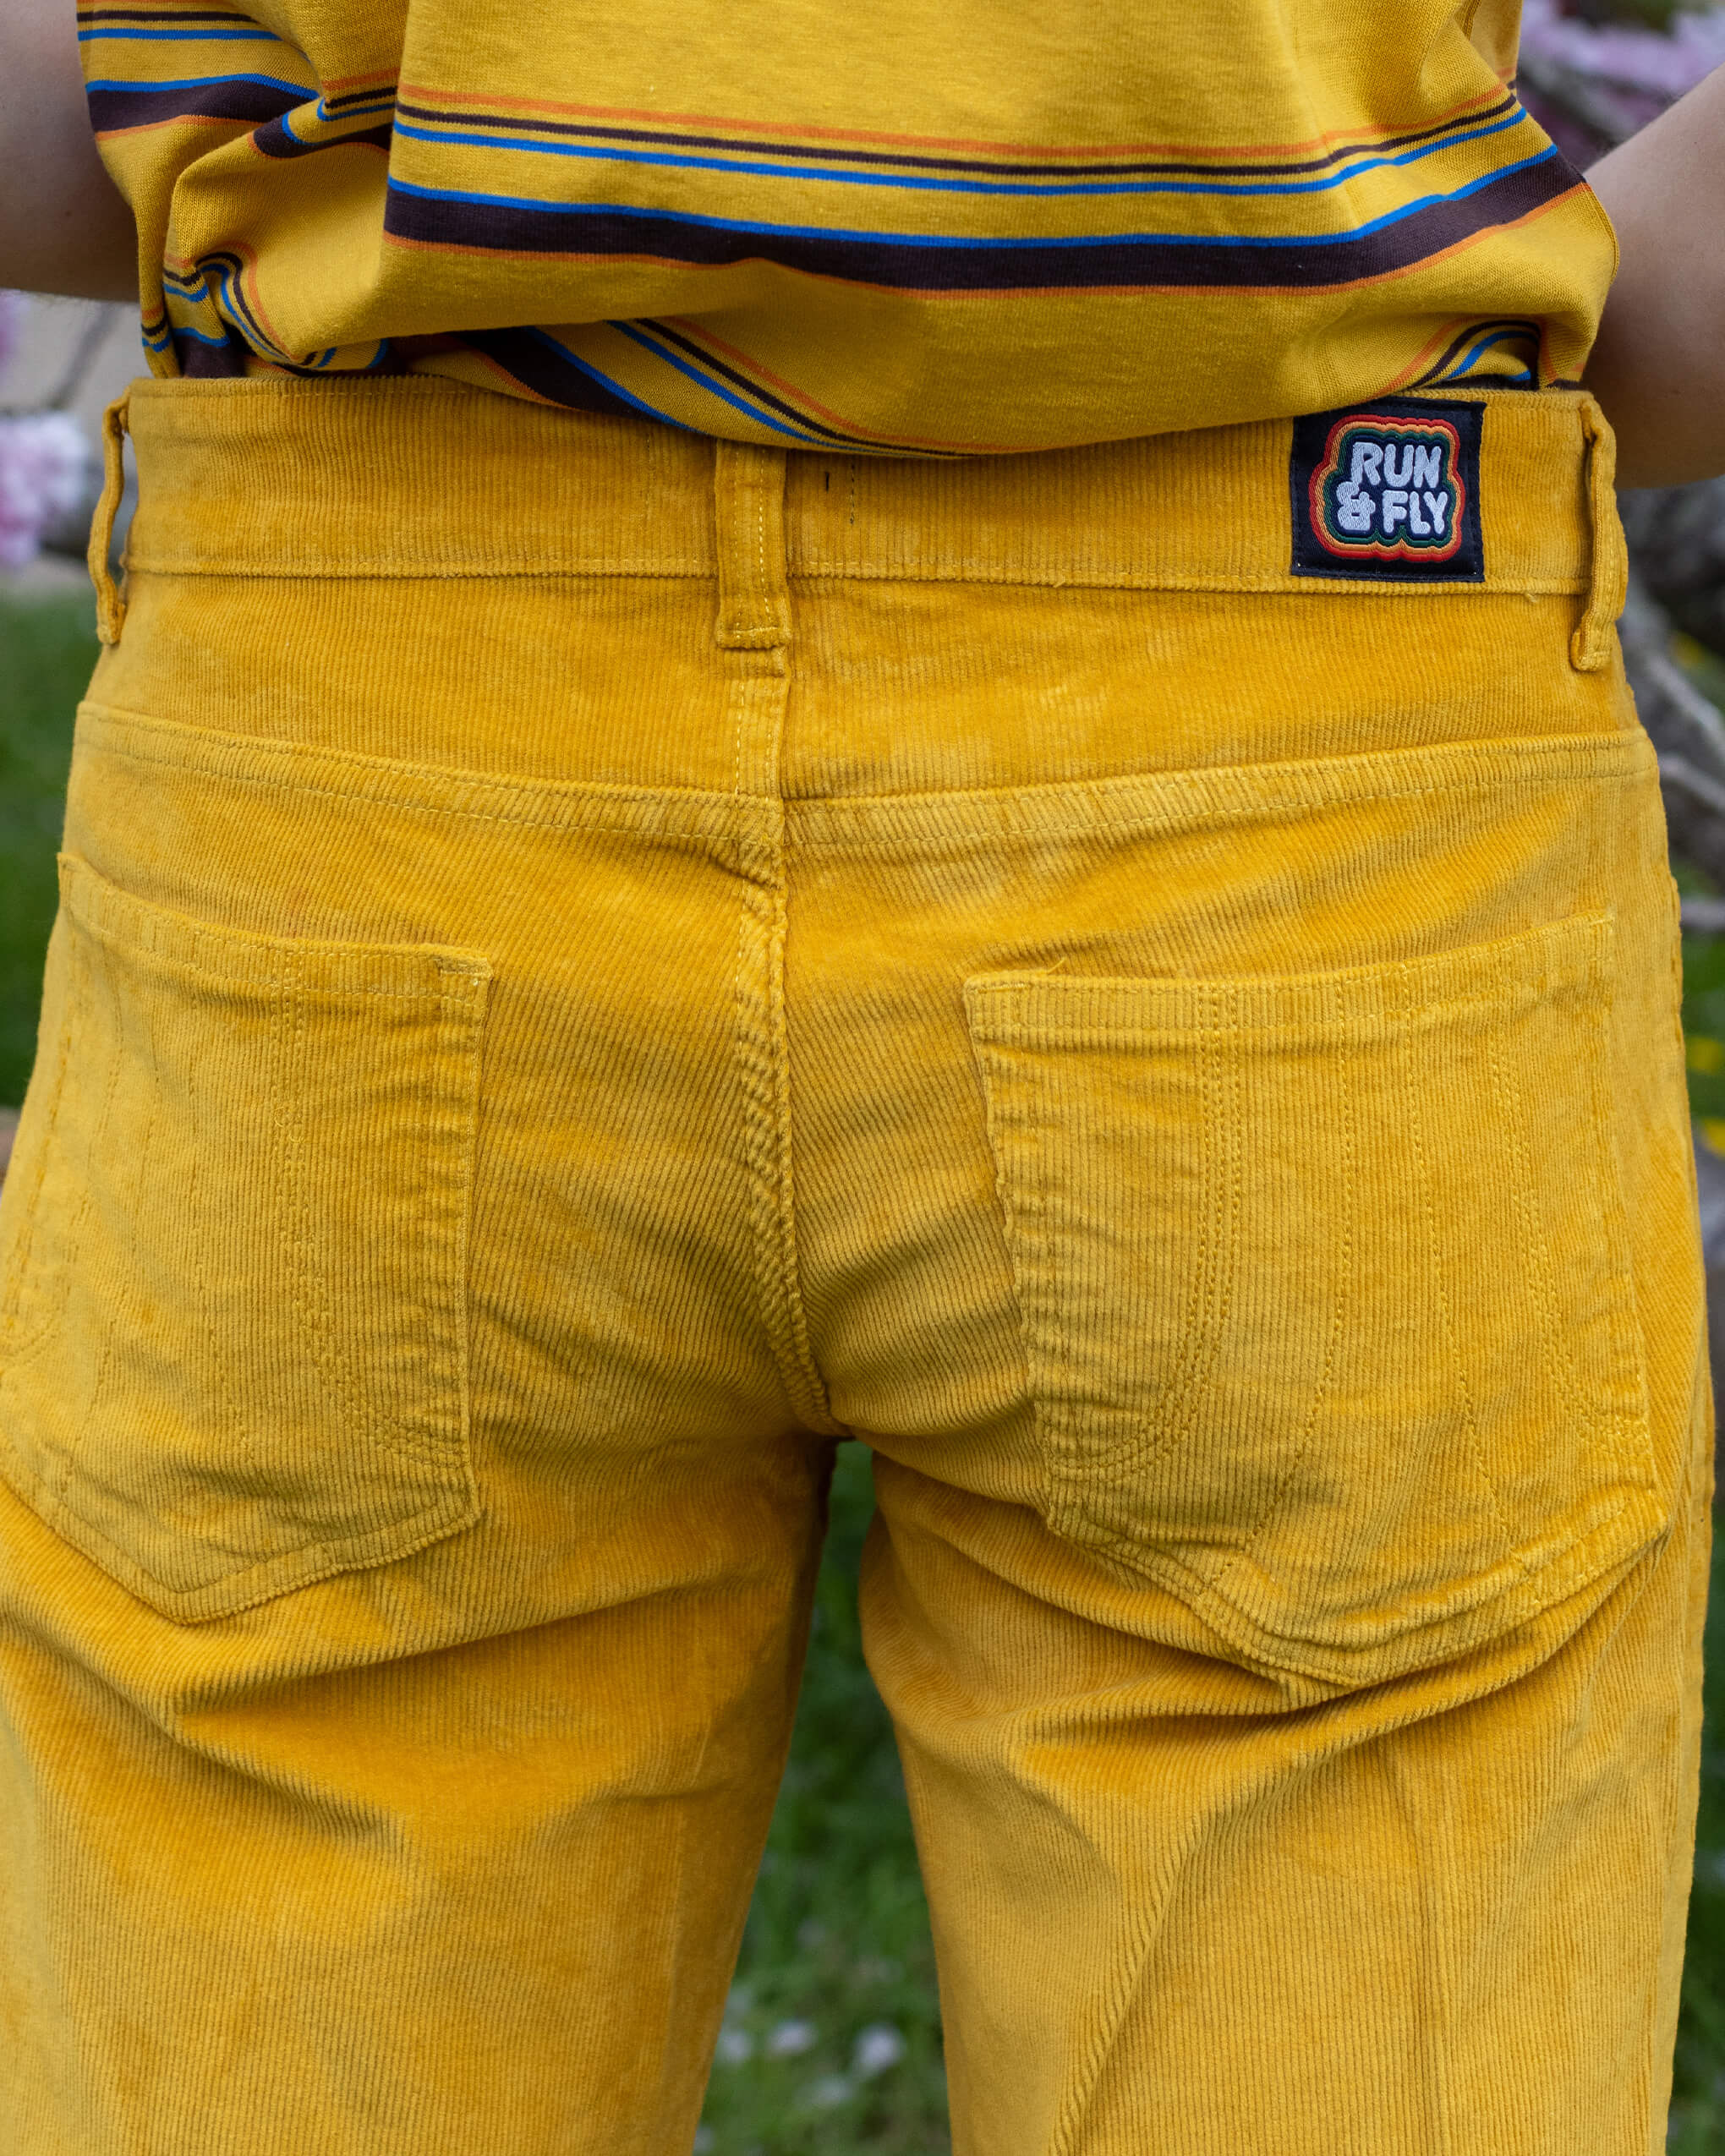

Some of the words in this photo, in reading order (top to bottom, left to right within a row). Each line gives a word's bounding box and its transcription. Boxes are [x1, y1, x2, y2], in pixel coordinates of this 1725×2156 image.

[1350, 441, 1442, 488] RUN
[1336, 481, 1376, 531] &
[1382, 490, 1448, 534] FLY
